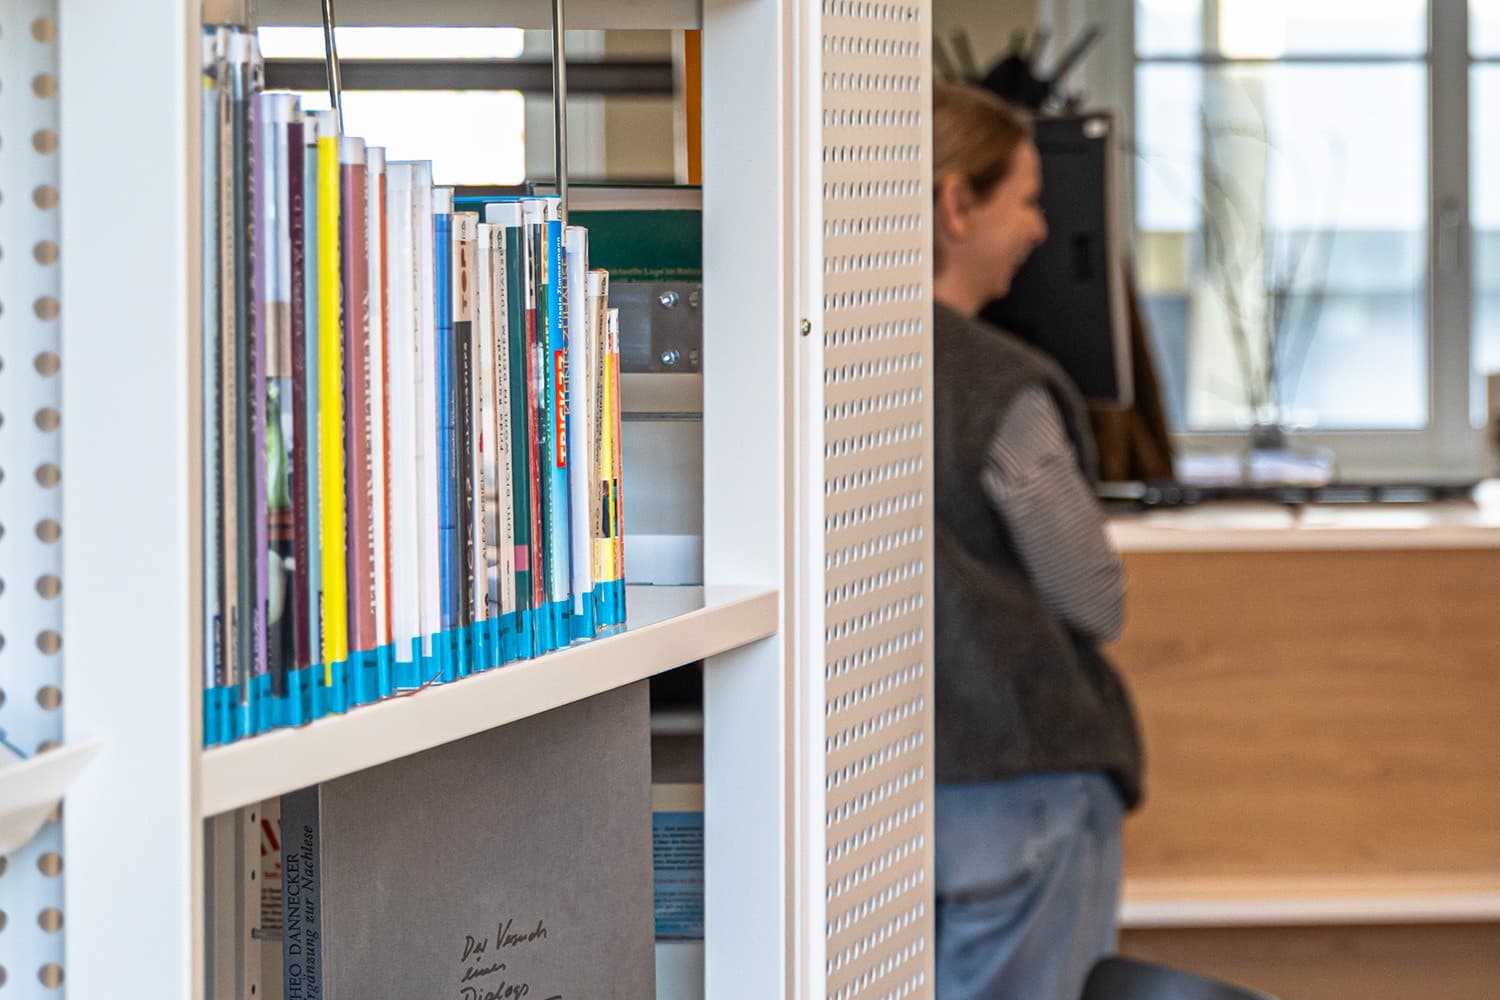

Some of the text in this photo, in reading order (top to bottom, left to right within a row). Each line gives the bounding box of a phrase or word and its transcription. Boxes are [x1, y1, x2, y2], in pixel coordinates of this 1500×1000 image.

[300, 825, 316, 892] Nachlese
[287, 853, 302, 956] DANNECKER
[305, 896, 316, 923] zur
[496, 918, 547, 950] Versuch
